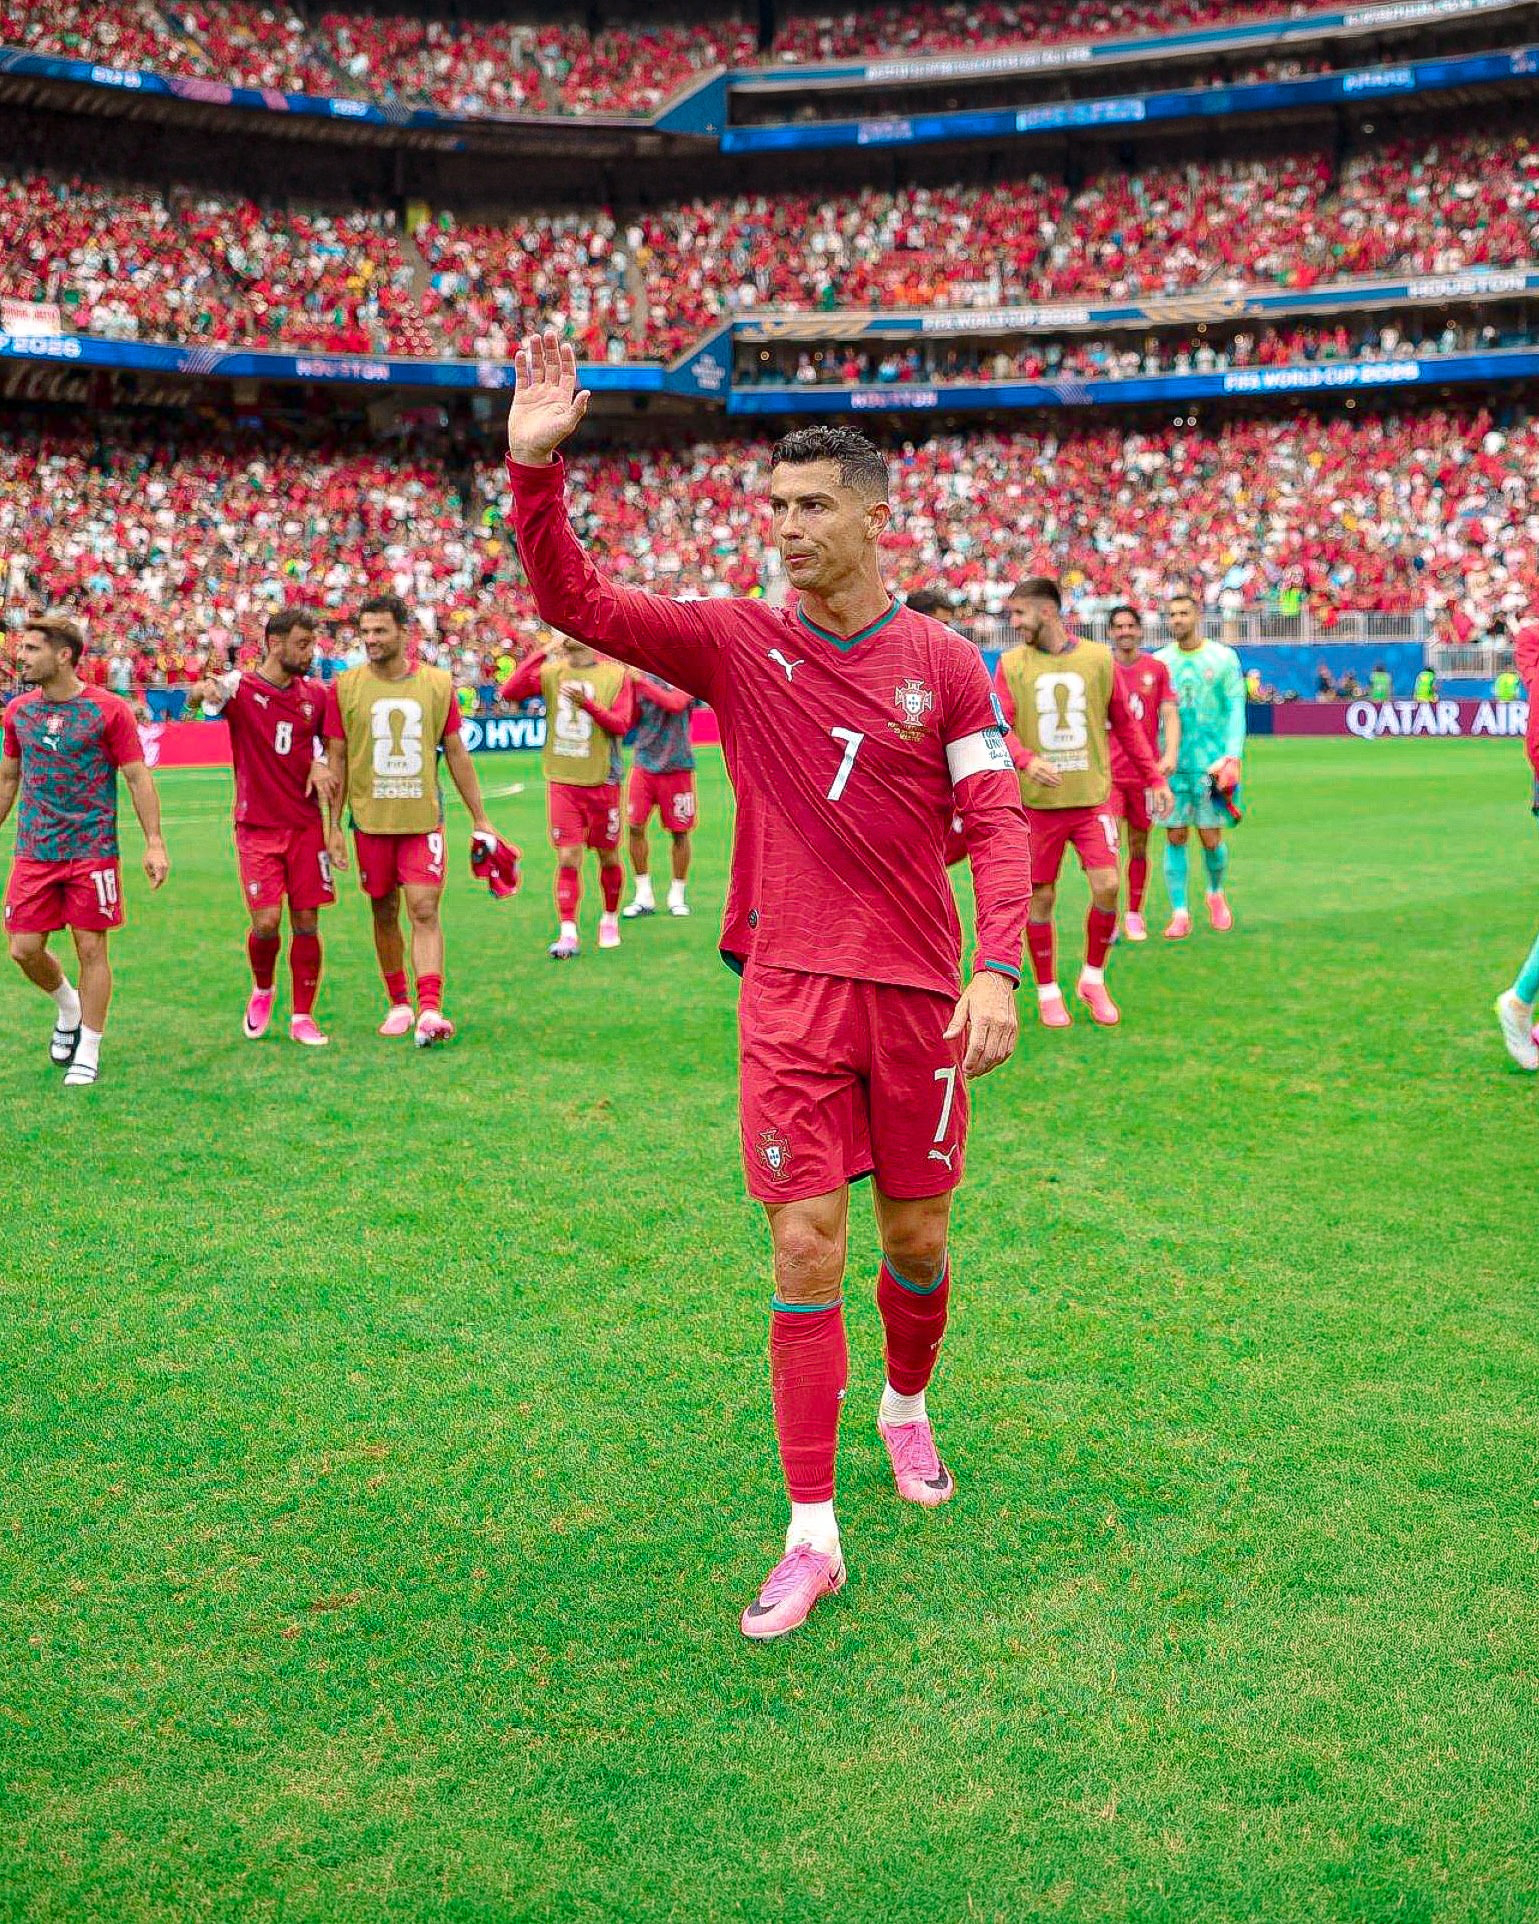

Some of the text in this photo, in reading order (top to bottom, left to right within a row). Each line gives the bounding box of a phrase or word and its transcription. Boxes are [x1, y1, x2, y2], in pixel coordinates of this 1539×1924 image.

[1263, 368, 1321, 389] WORLD
[274, 720, 294, 756] 8
[485, 719, 547, 748] HYU
[1346, 701, 1530, 739] QATAR AIR
[826, 726, 865, 801] 7
[426, 832, 443, 865] 9
[934, 1065, 957, 1143] 7
